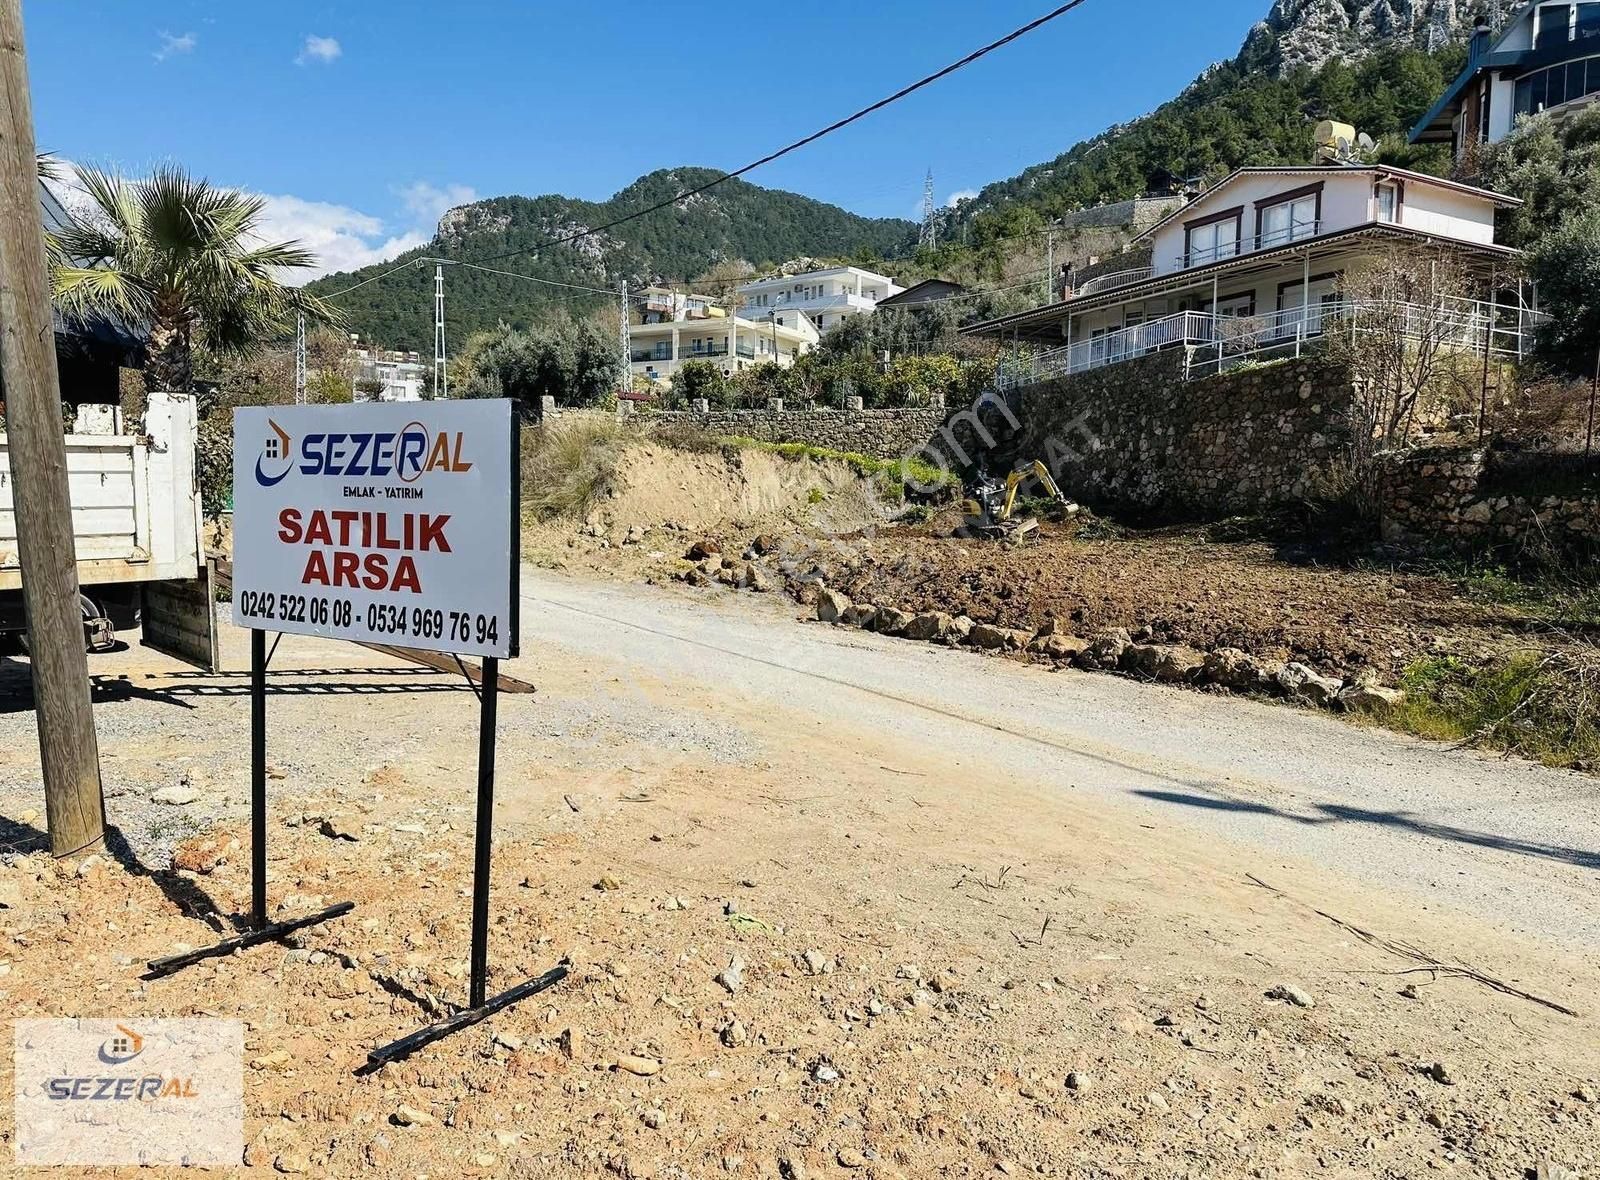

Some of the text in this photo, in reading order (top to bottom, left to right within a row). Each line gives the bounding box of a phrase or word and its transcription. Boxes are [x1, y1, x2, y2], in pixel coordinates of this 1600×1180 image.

[300, 432, 473, 476] SEZERAL
[343, 486, 375, 498] EMLAK
[384, 487, 423, 499] YATIRIM
[278, 508, 452, 552] SATILIK
[301, 550, 422, 593] ARSA
[241, 590, 275, 619] 0242
[279, 594, 306, 622] 522
[310, 597, 328, 625] 06
[333, 599, 351, 628] 08
[367, 603, 407, 634] 0534
[412, 607, 443, 639] 969
[449, 612, 470, 642] 76
[476, 614, 498, 645] 94
